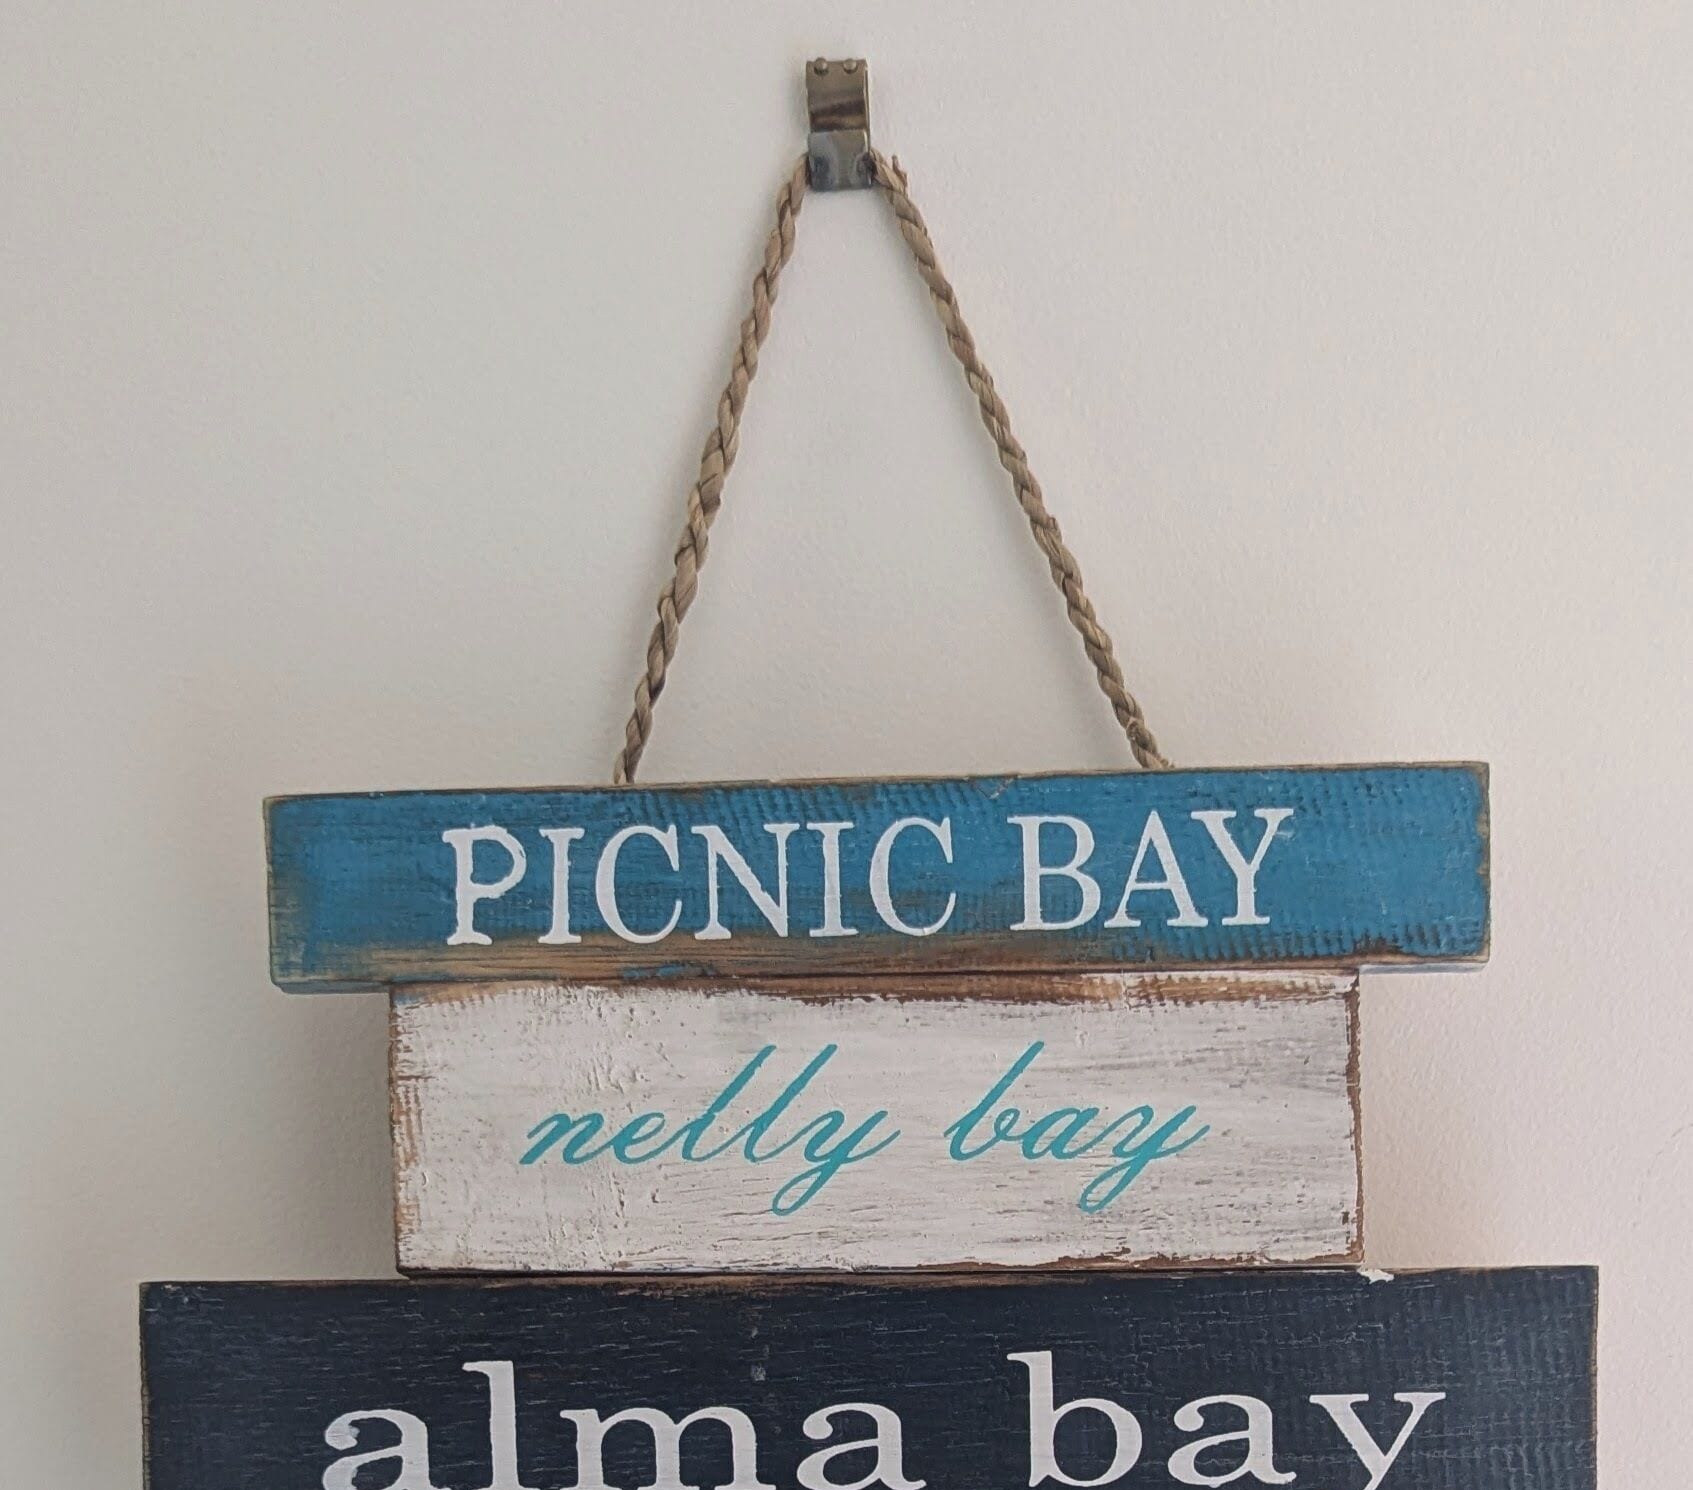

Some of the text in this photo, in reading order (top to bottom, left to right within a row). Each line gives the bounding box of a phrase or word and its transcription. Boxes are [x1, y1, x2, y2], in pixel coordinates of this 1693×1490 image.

[442, 808, 1294, 945] PICNIC BAY
[521, 1041, 1209, 1215] nelly bay
